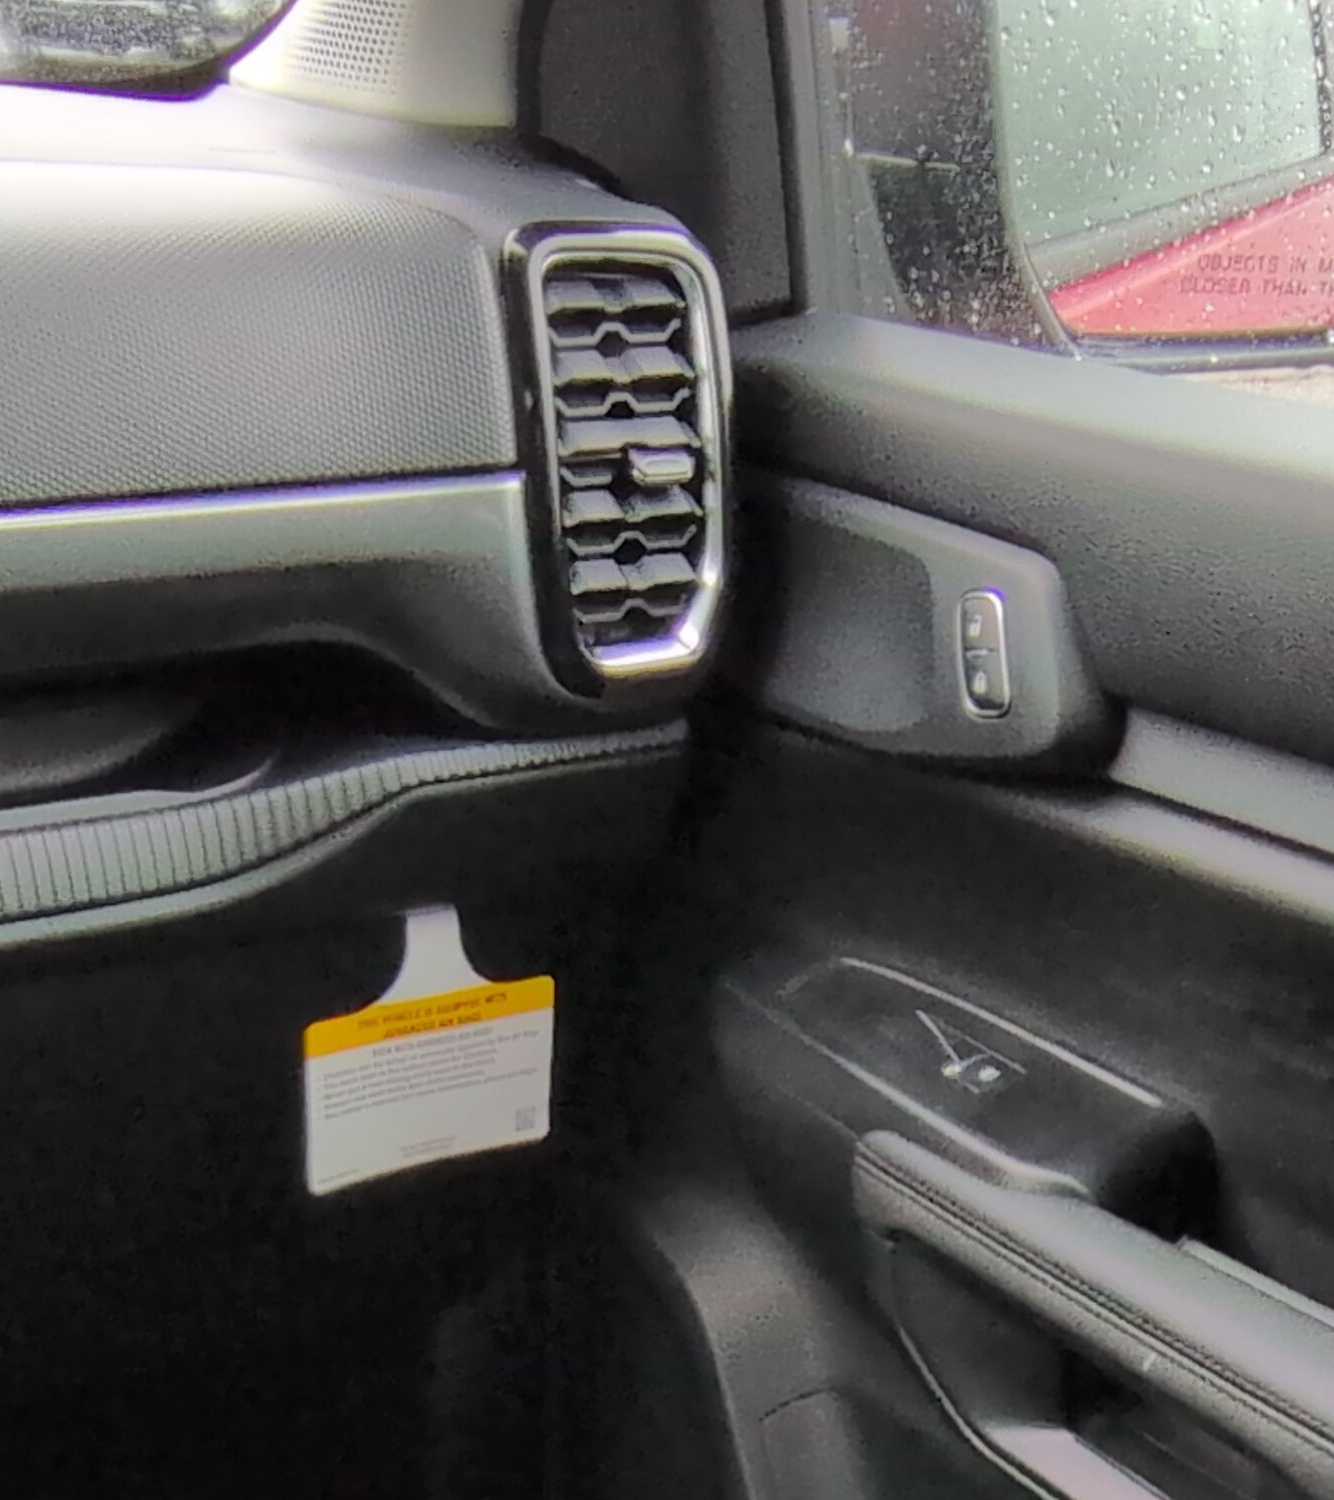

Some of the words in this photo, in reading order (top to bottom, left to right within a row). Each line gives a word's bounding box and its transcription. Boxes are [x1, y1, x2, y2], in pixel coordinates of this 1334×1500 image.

[1197, 253, 1279, 274] OBJECTS
[1288, 254, 1307, 274] IN
[1179, 275, 1251, 295] CLOSER
[1262, 277, 1308, 297] THAN
